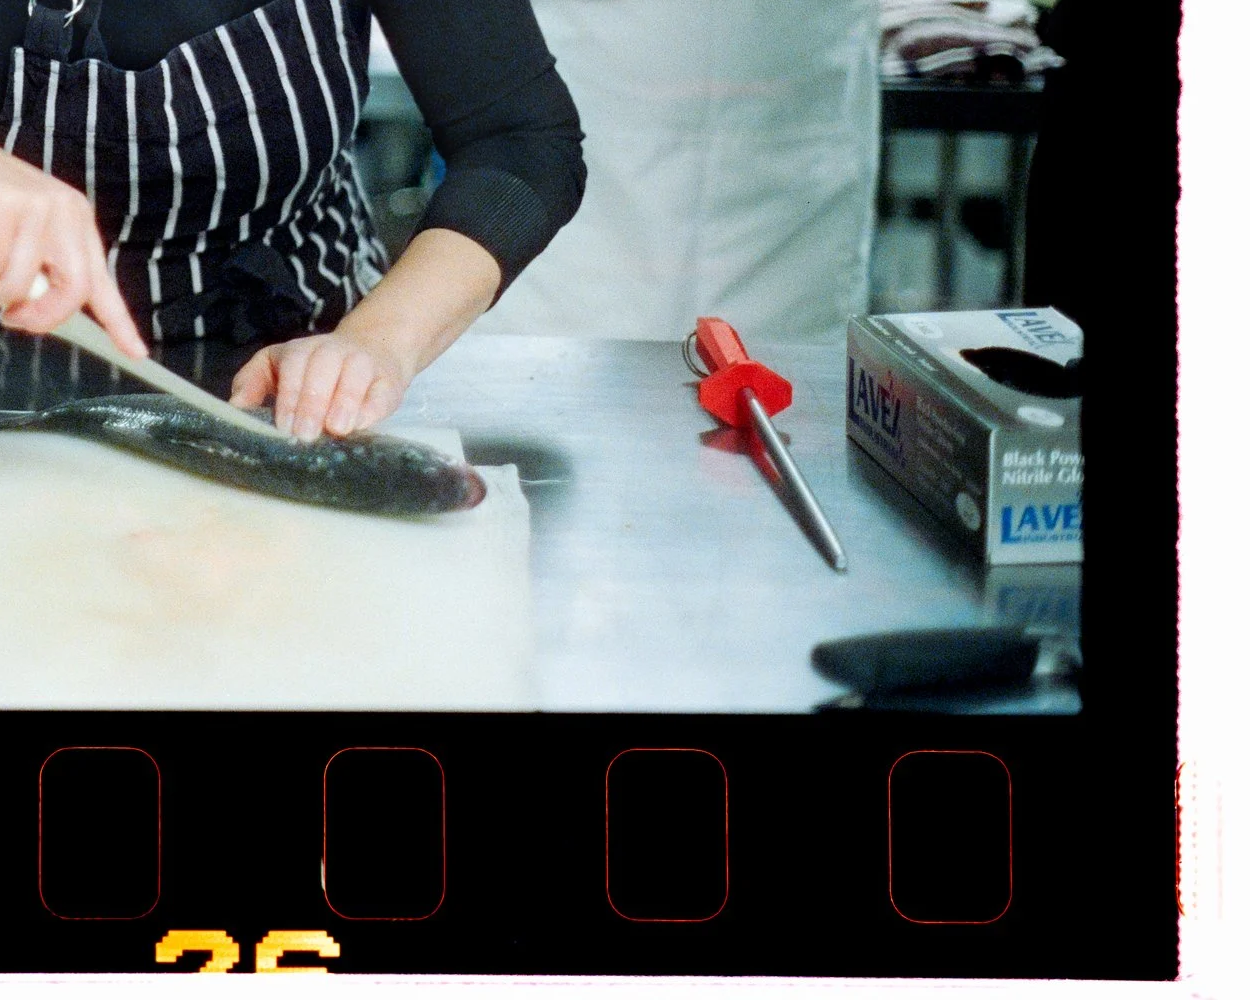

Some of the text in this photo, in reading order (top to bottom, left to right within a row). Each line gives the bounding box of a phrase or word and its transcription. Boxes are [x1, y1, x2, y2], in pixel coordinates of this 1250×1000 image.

[1002, 446, 1085, 469] Black Pow
[1001, 467, 1054, 486] Nitrile
[1001, 503, 1084, 545] LAVE
